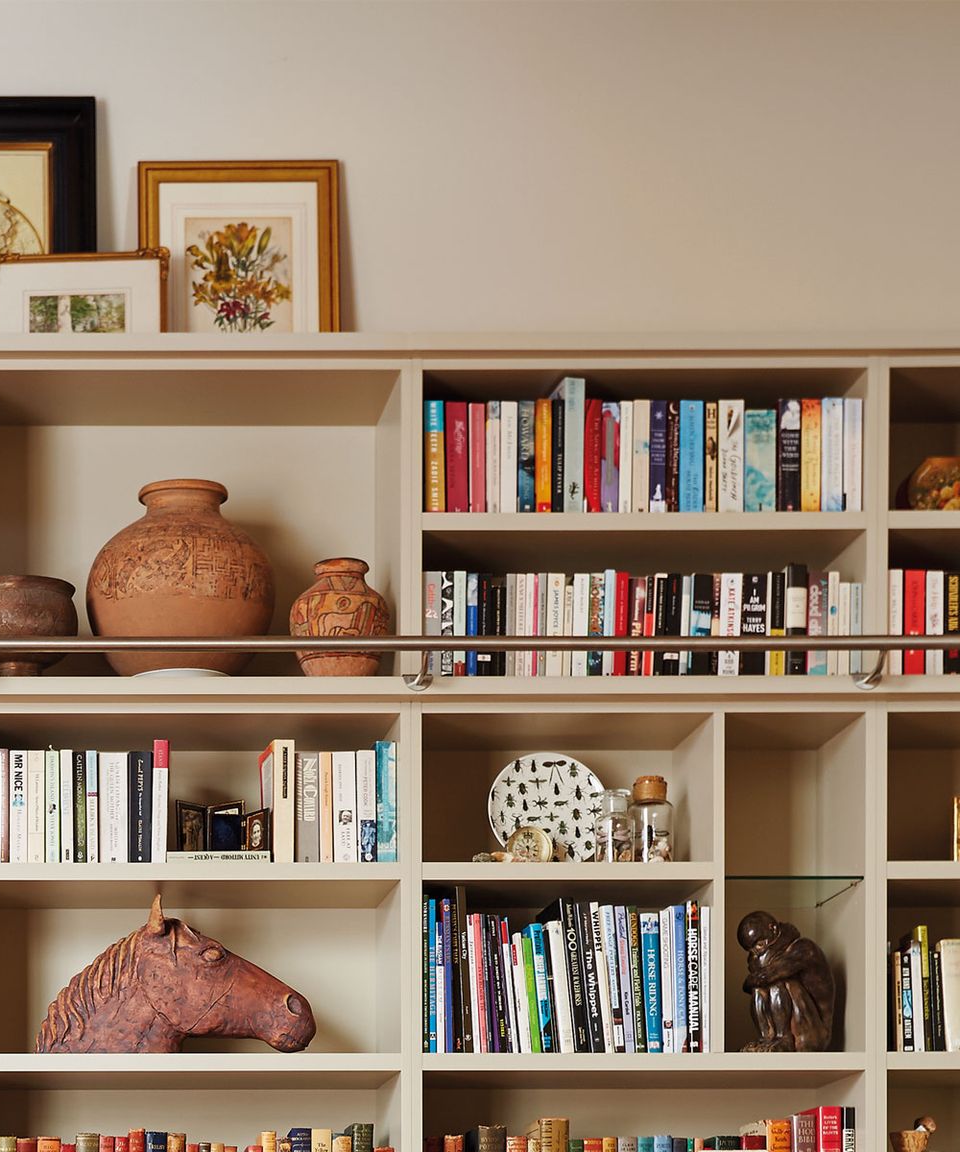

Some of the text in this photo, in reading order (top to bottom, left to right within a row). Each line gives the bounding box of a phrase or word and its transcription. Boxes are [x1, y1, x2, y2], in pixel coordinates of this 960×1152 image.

[809, 586, 821, 616] cloud
[948, 576, 959, 630] SCHINDLER'S ARK
[743, 624, 765, 632] HAYES
[14, 754, 23, 791] MR NICE
[592, 911, 602, 952] WHIPPET
[567, 928, 582, 1006] 100 GREATEST RACEHORSES
[631, 948, 639, 968] Training
[688, 929, 698, 1033] HORSE CARE MANUAL
[585, 949, 598, 1017] The Whippet
[647, 949, 657, 1016] HORSE RIDING
